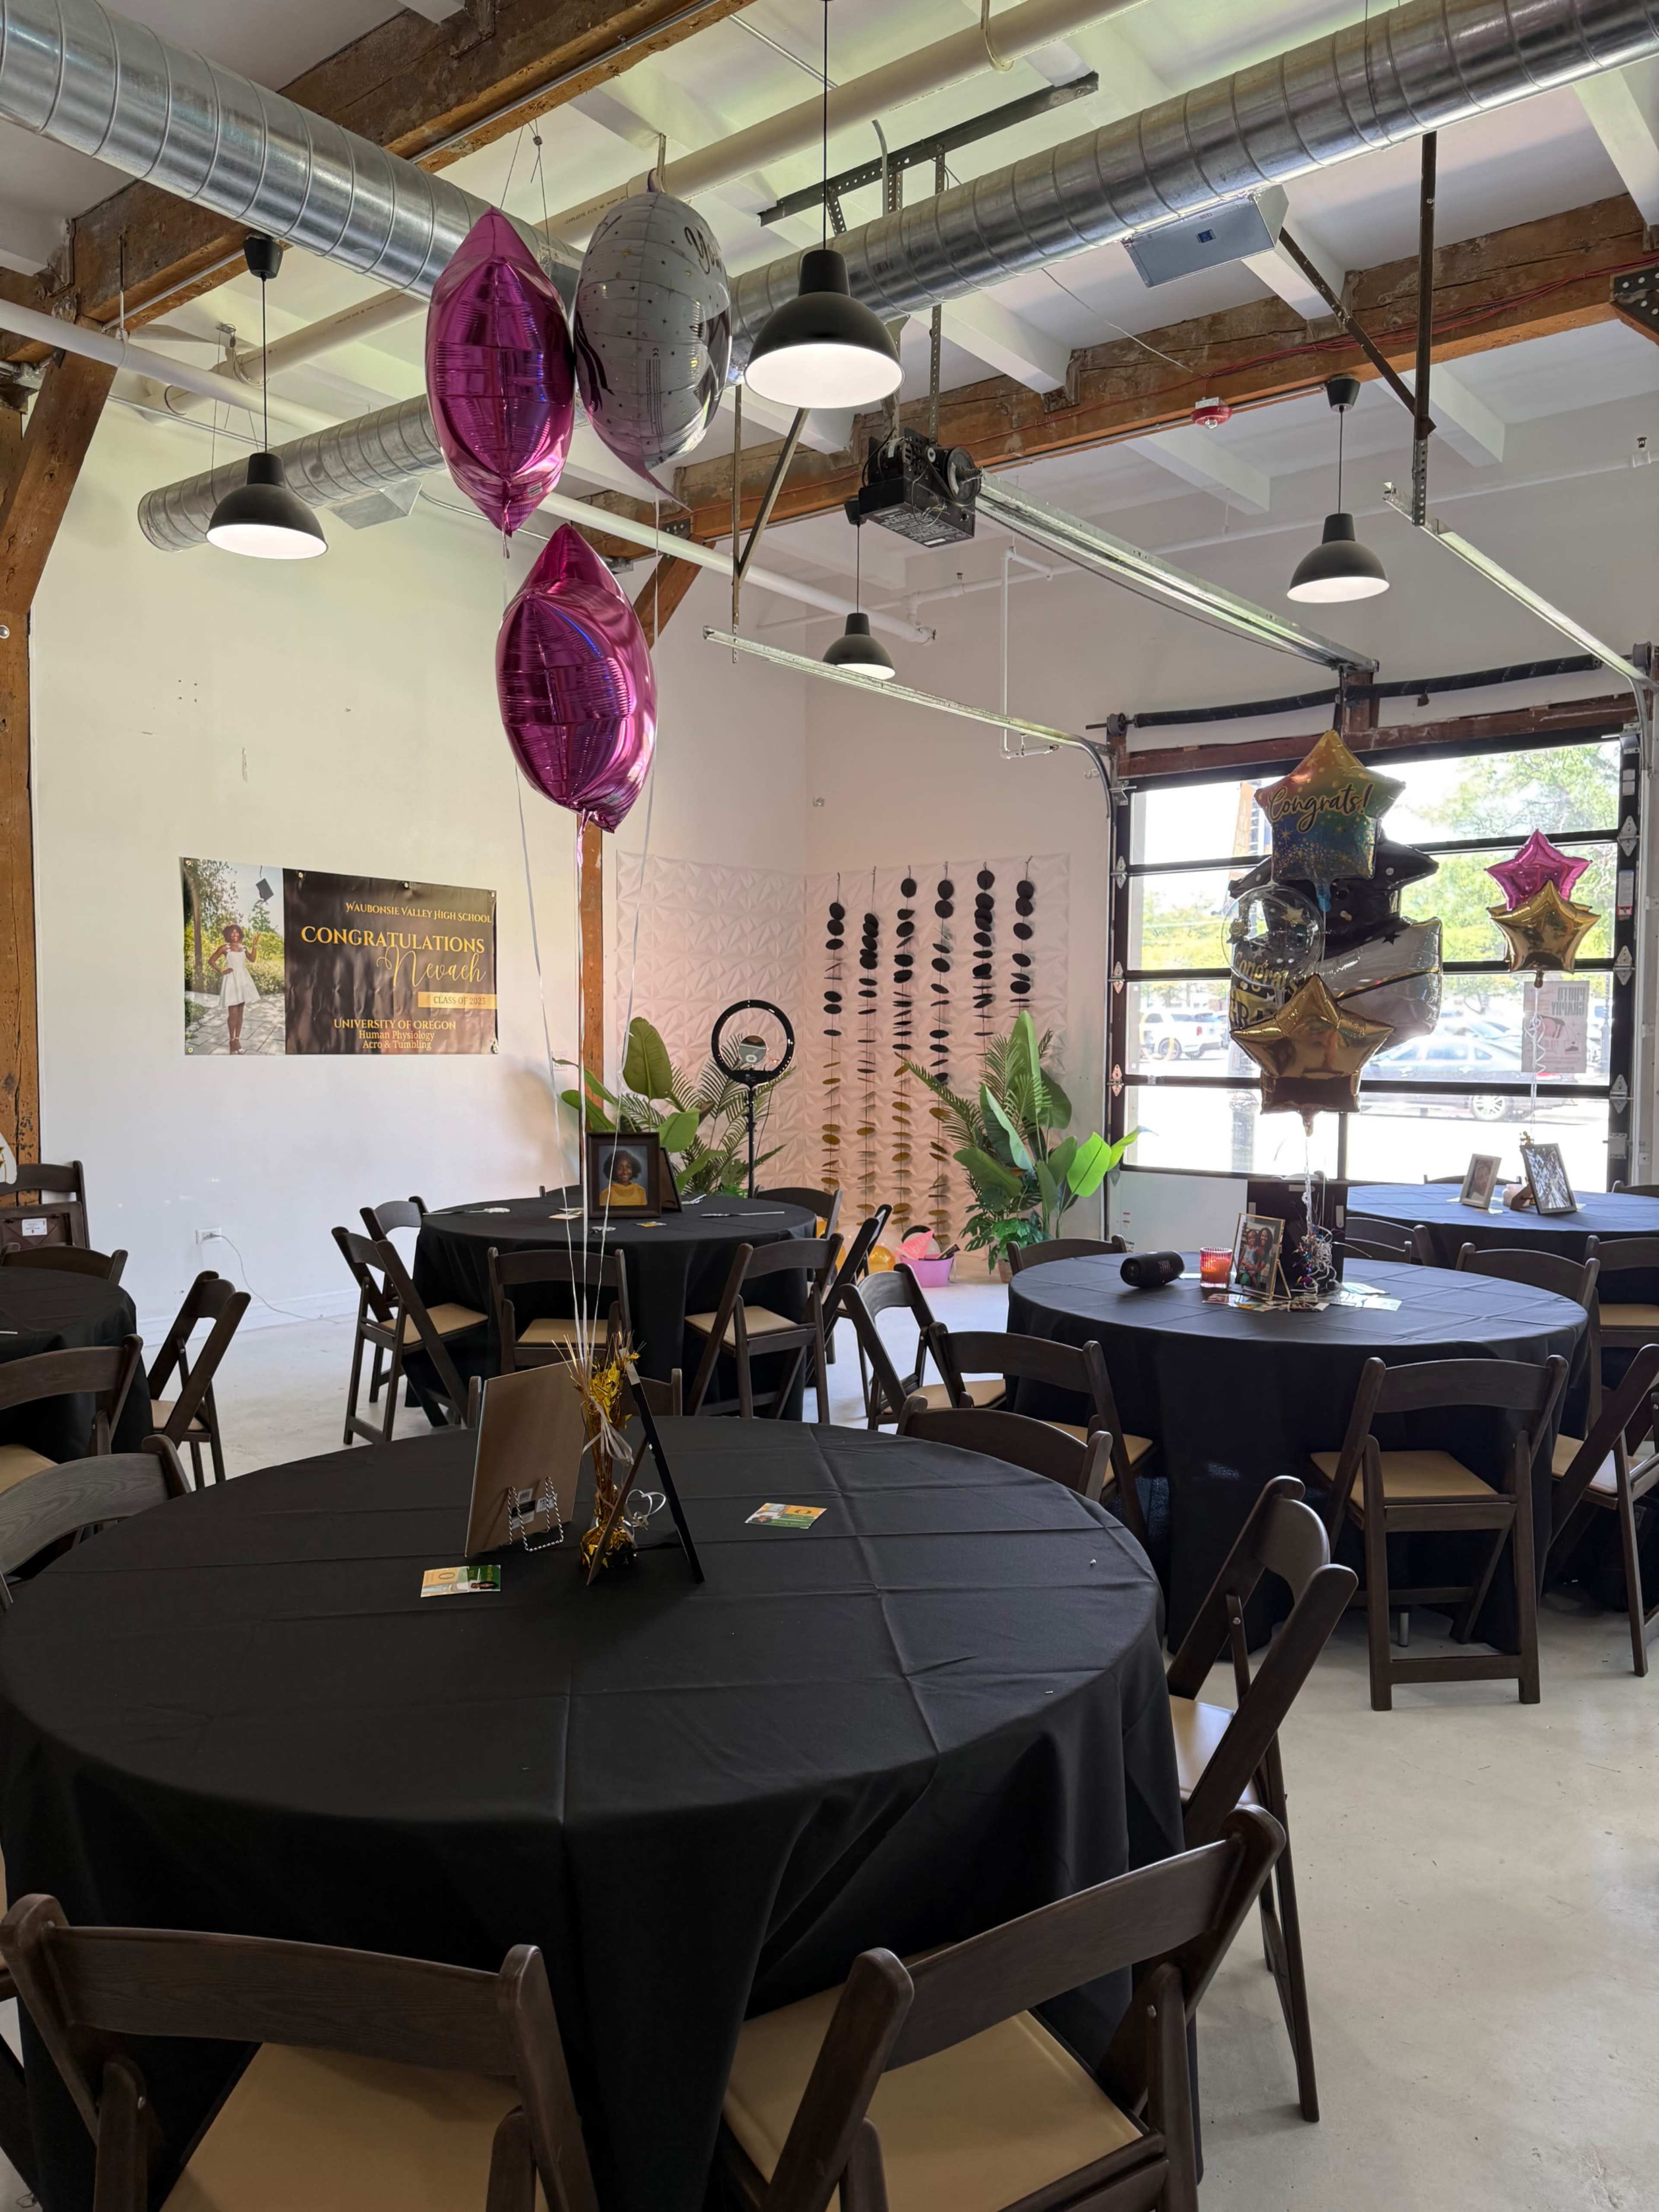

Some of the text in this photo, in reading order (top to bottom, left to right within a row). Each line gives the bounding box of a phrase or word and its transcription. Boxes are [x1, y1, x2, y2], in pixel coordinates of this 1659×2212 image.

[1269, 783, 1374, 832] Congrats!
[346, 901, 492, 923] WAUBONSIE VALLEY HIGH SCHOOL
[301, 926, 485, 954] CONGRATULATIONS
[376, 944, 486, 988] Nevaeh
[433, 996, 456, 1004] CLASS
[458, 996, 467, 1005] OF
[333, 1017, 456, 1030] UNIVERSITY OF OREGON
[359, 1030, 435, 1041] Human Physiology
[362, 1040, 432, 1051] Acro & Tumbling
